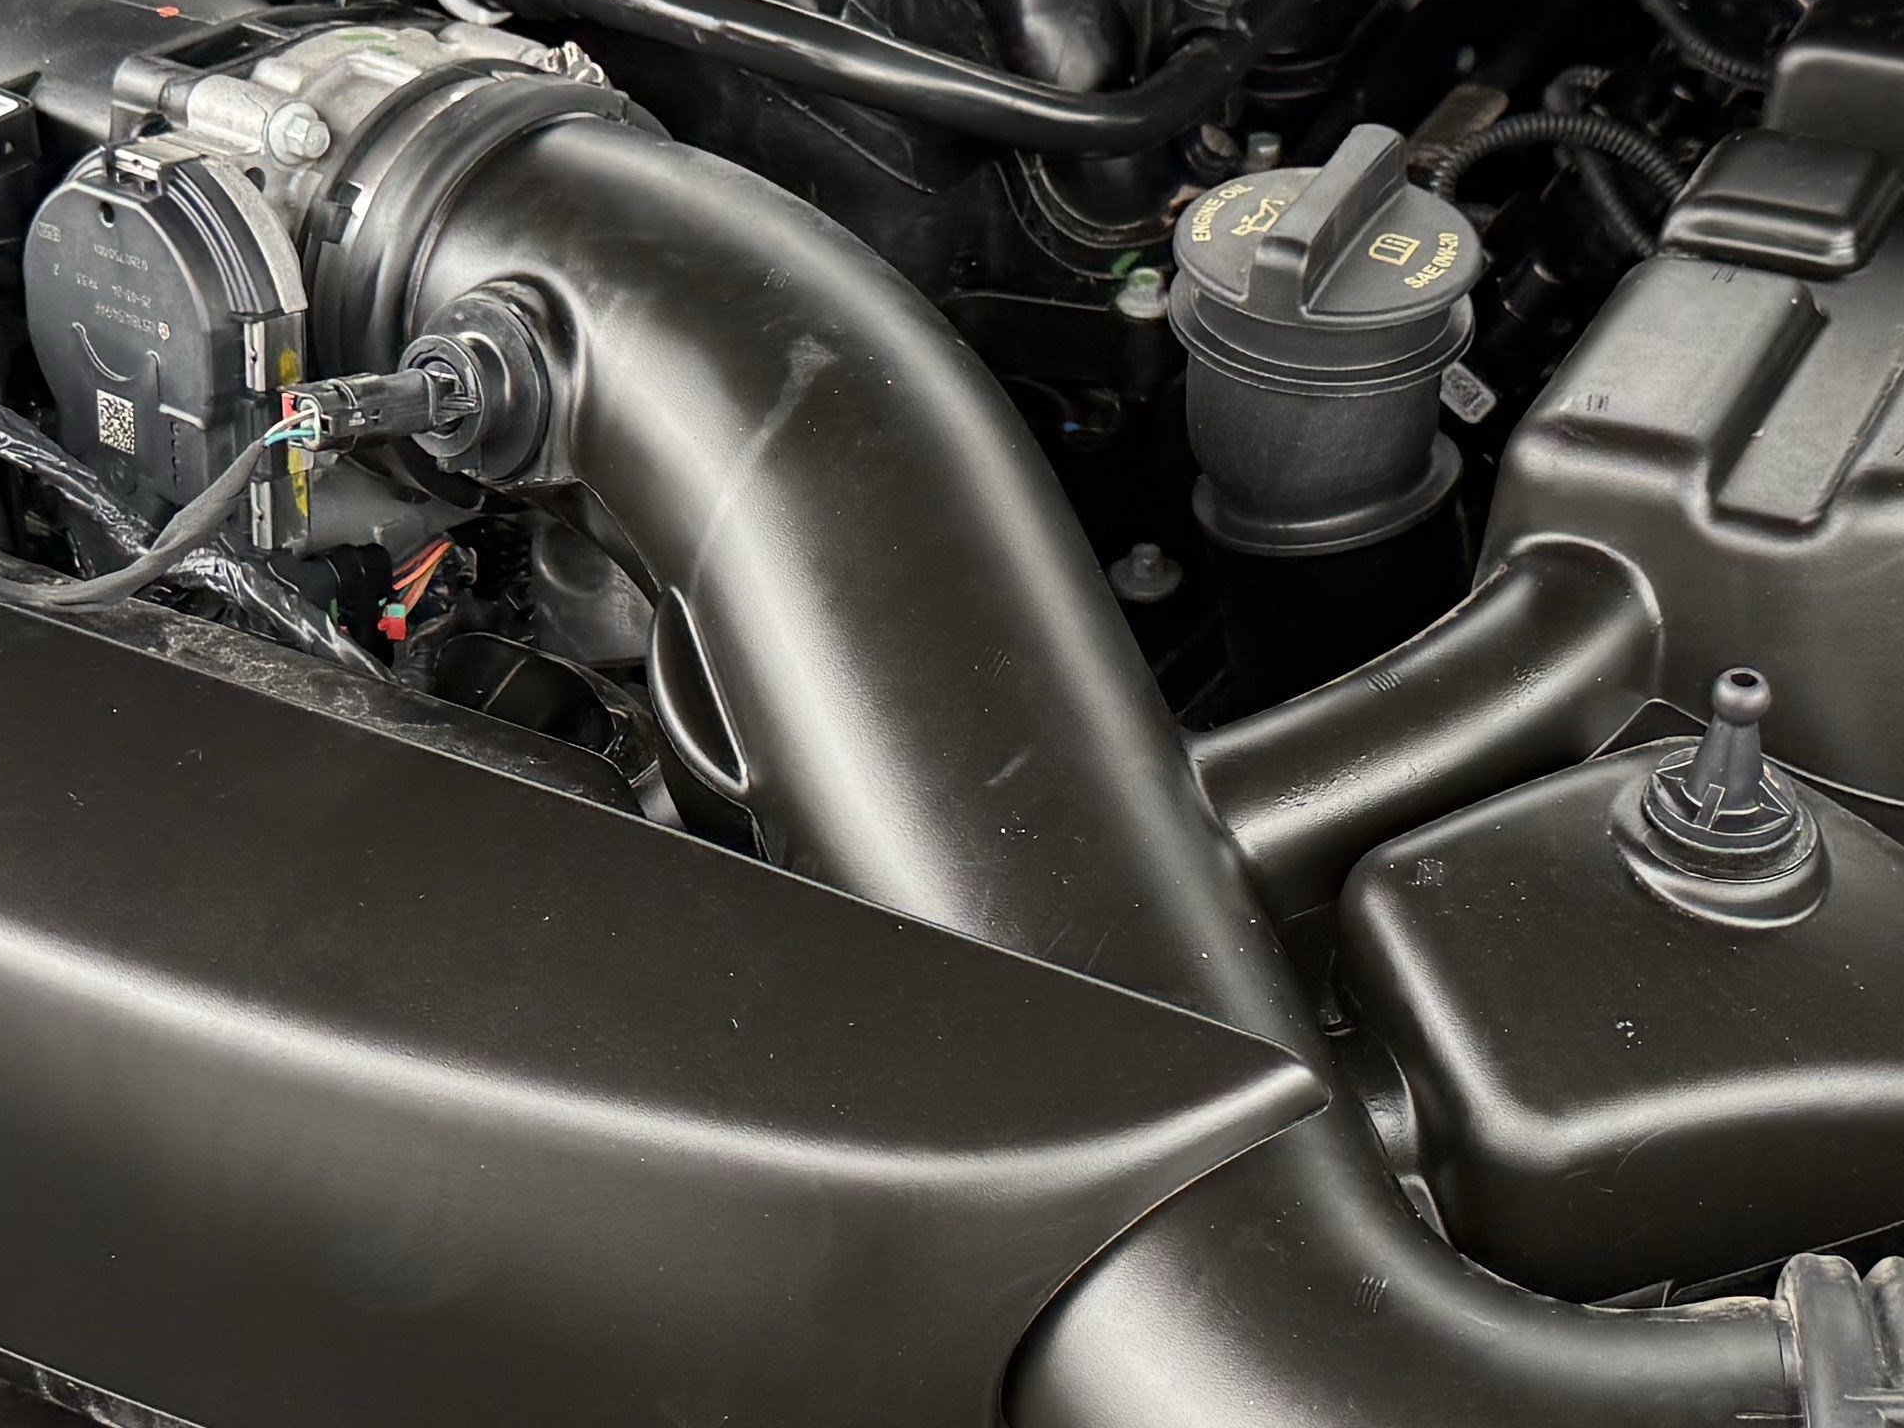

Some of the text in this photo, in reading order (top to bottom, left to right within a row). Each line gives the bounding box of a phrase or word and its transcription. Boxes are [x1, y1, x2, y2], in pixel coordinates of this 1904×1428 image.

[1192, 183, 1255, 243] ENGINE OIL
[1403, 262, 1442, 289] SAE
